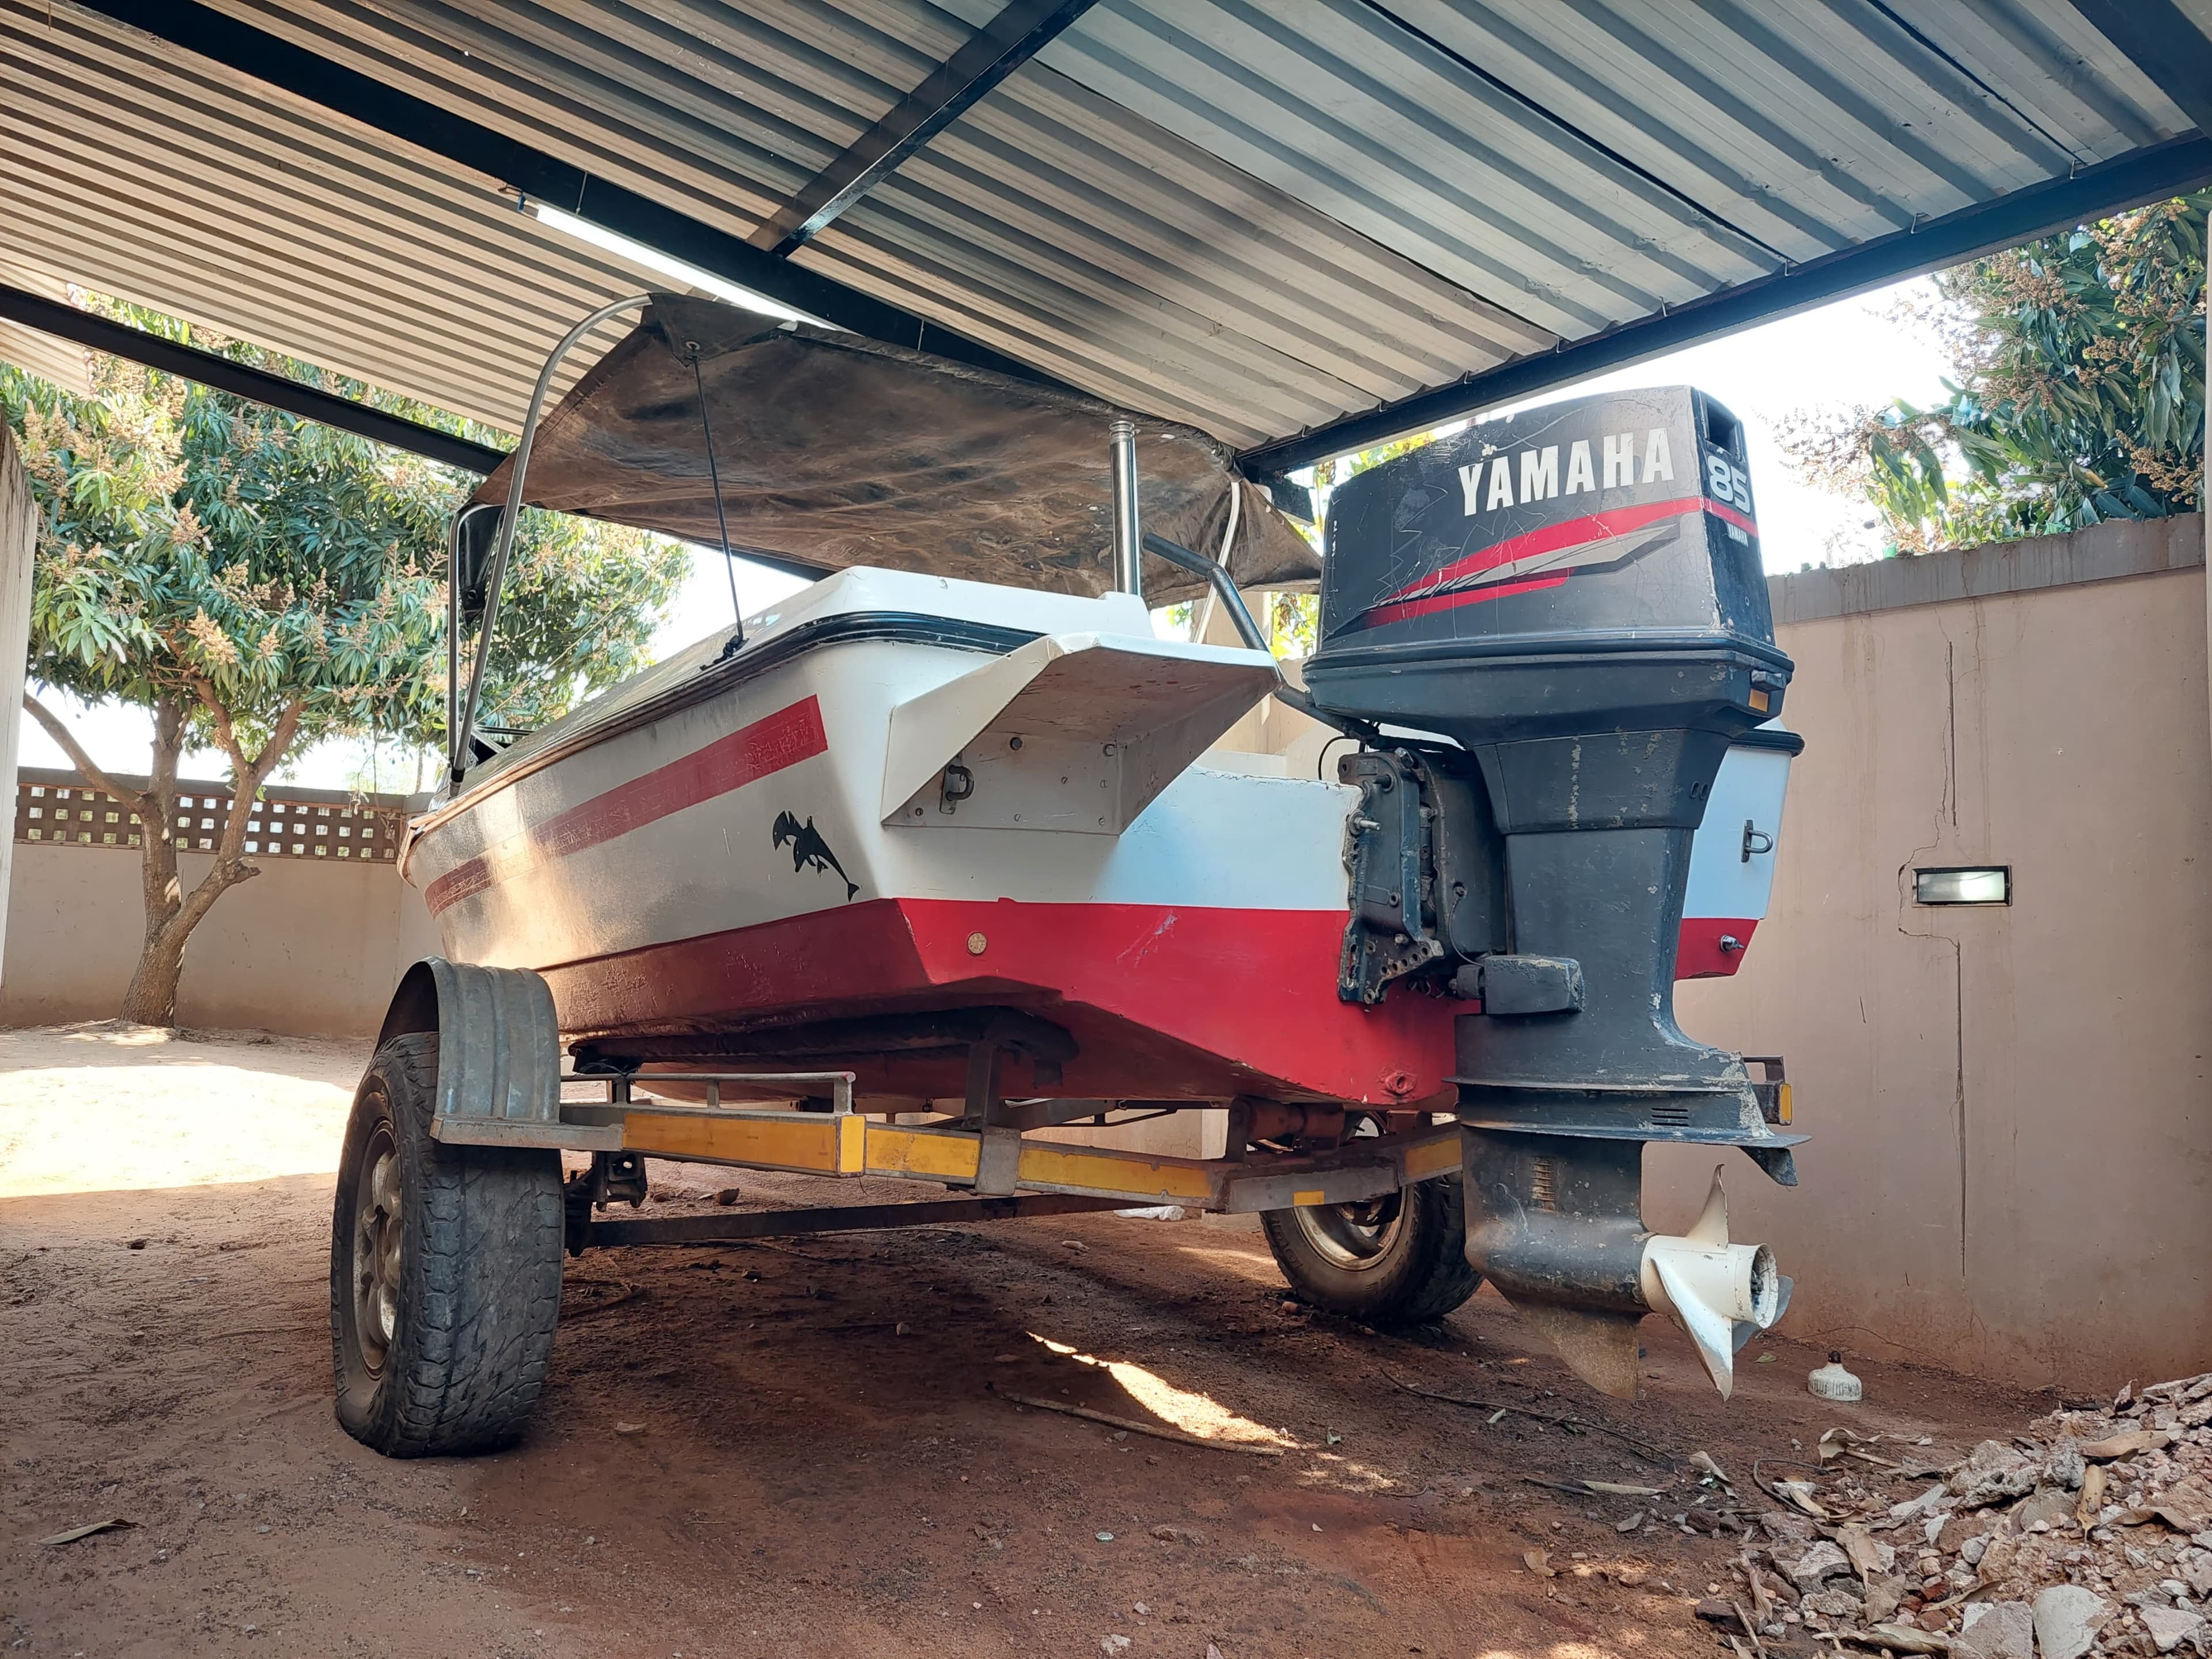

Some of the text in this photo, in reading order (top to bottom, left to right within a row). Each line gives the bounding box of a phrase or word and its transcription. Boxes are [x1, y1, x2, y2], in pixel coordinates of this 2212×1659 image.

[1458, 428, 1674, 516] YAMAHA
[1708, 455, 1750, 514] 85
[1727, 522, 1748, 547] YAMAHA
